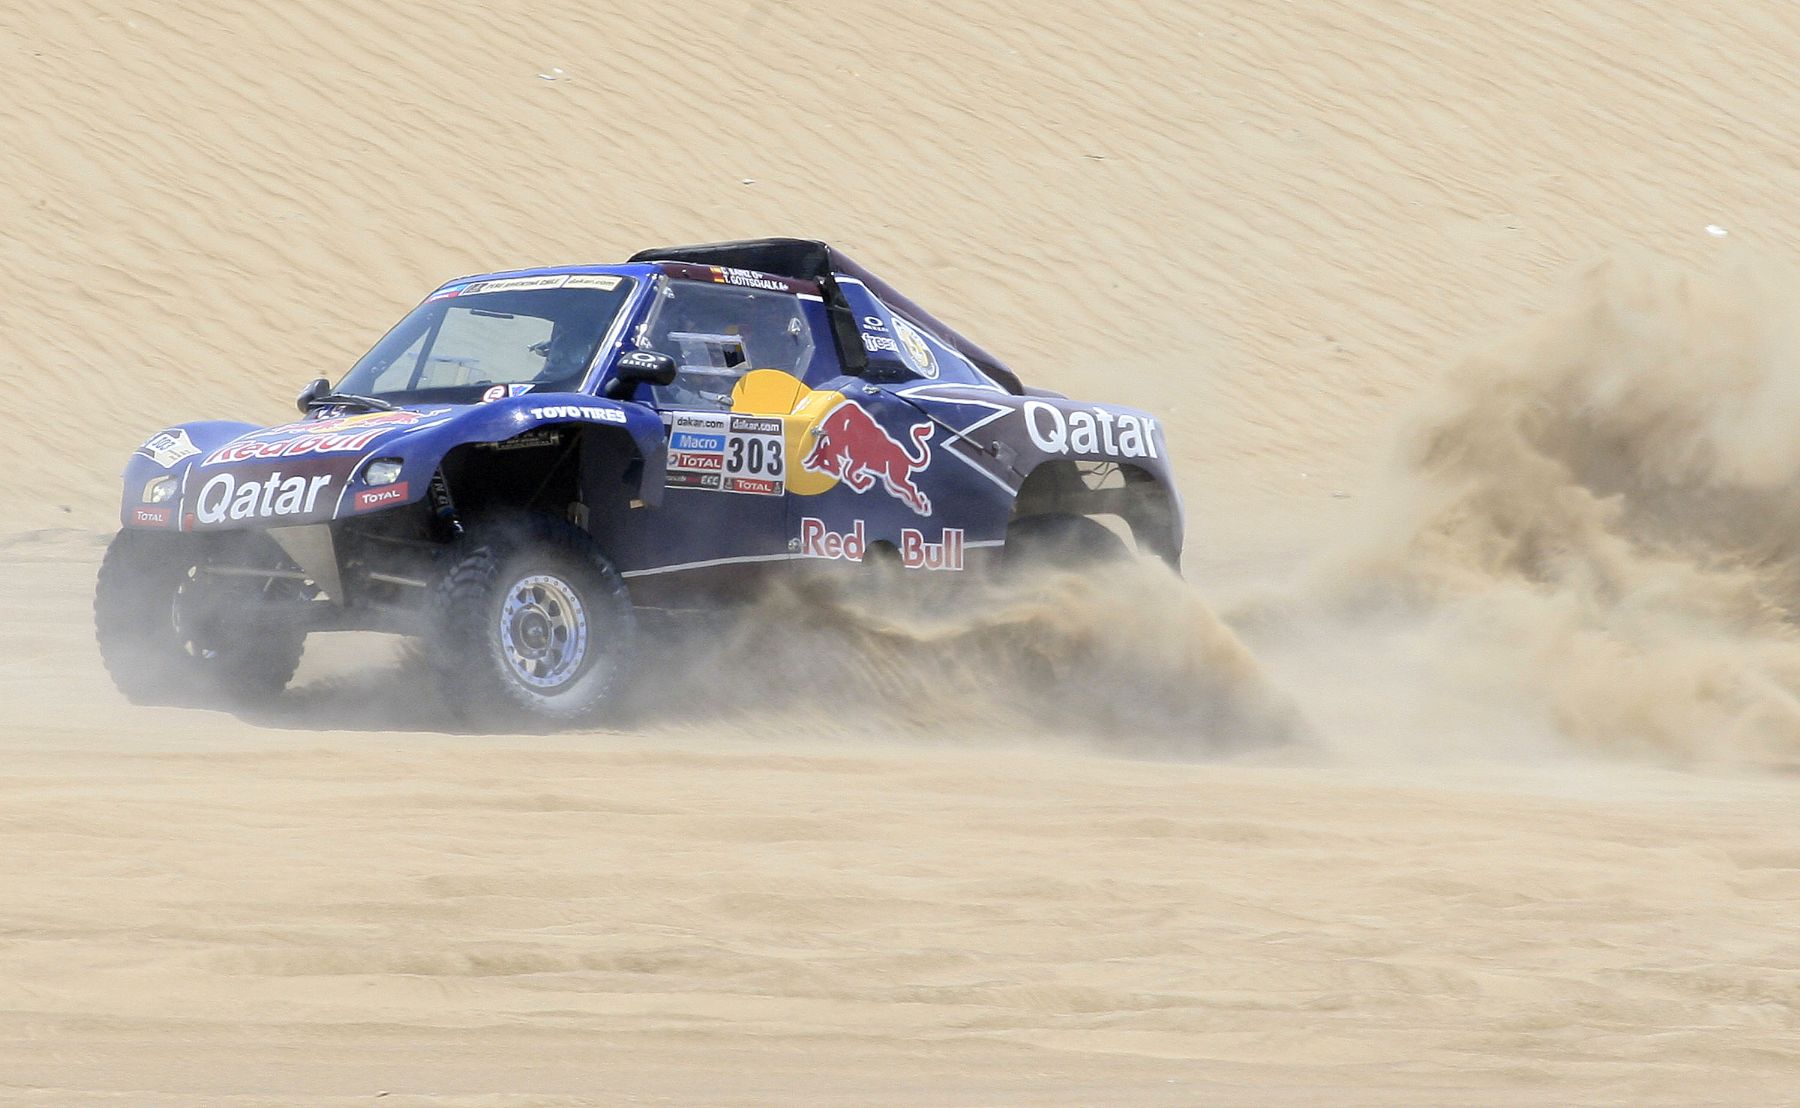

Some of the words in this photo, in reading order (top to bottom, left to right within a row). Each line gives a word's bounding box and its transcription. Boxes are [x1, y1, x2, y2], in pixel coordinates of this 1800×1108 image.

[567, 278, 616, 287] dakar.com
[730, 275, 778, 290] GOTTSCHALK
[622, 359, 658, 369] OAKLEY
[530, 406, 580, 420] TOYO
[580, 406, 627, 423] TIRES
[677, 417, 724, 429] dakar.com
[732, 419, 780, 432] dakar.com
[1023, 400, 1158, 459] Qatar
[201, 437, 297, 467] Red
[283, 427, 397, 457] Bull
[680, 435, 718, 449] Macro
[681, 454, 721, 468] TOTAL
[726, 437, 784, 476] 303
[736, 480, 772, 492] TOTAL
[196, 472, 332, 524] Qatar
[361, 489, 401, 504] TOTAL
[137, 511, 164, 522] TOTAL
[801, 517, 866, 563] Red
[901, 527, 964, 571] Bull
